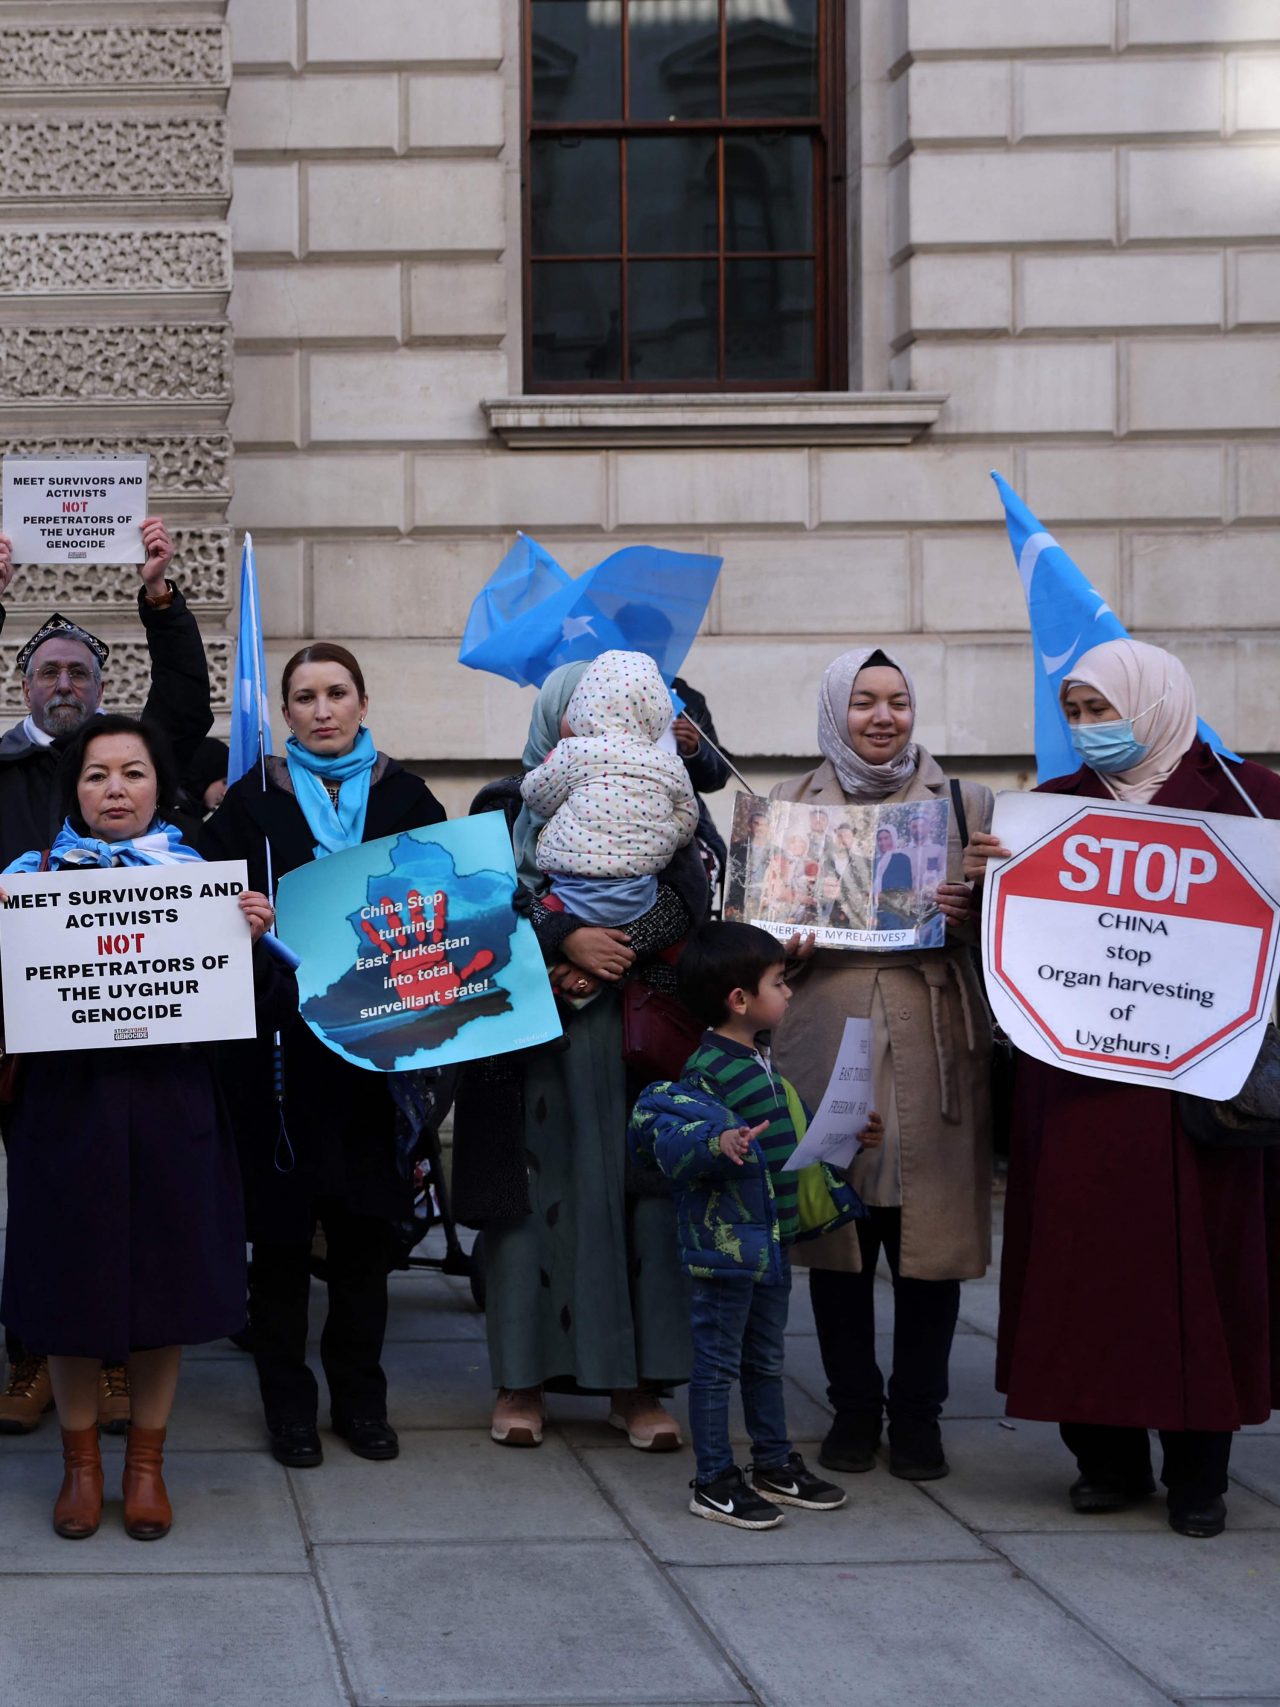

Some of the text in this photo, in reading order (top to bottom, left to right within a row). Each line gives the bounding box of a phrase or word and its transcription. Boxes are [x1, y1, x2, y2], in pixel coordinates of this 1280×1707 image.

[13, 477, 45, 485] MEET
[48, 477, 115, 485] SURVIVORS
[46, 489, 106, 497] ACTIVISTS
[63, 502, 88, 512] NOT
[23, 516, 113, 524] PERPETRATORS
[40, 528, 115, 536] THE UYGHUR
[1059, 834, 1218, 904] STOP
[4, 882, 243, 910] MEET SURVIVORS AND
[361, 893, 442, 920] China Stop
[66, 909, 179, 929] ACTIVISTS
[1098, 912, 1168, 936] CHINA
[379, 920, 435, 940] turning
[825, 931, 843, 940] MY
[846, 932, 905, 942] RELATIVES?
[97, 933, 145, 955] NOT
[356, 937, 469, 971] East Turkestan
[1106, 945, 1151, 966] stop
[26, 955, 229, 981] PERPETRATORS OF
[384, 962, 453, 989] into total
[58, 980, 199, 1001] THE UYGHUR
[1038, 964, 1214, 1008] Organ harvesting
[360, 979, 489, 1019] surveillant state!
[72, 1004, 182, 1023] GENOCIDE
[1110, 1005, 1135, 1021] of
[115, 1032, 148, 1040] GENOCIDE
